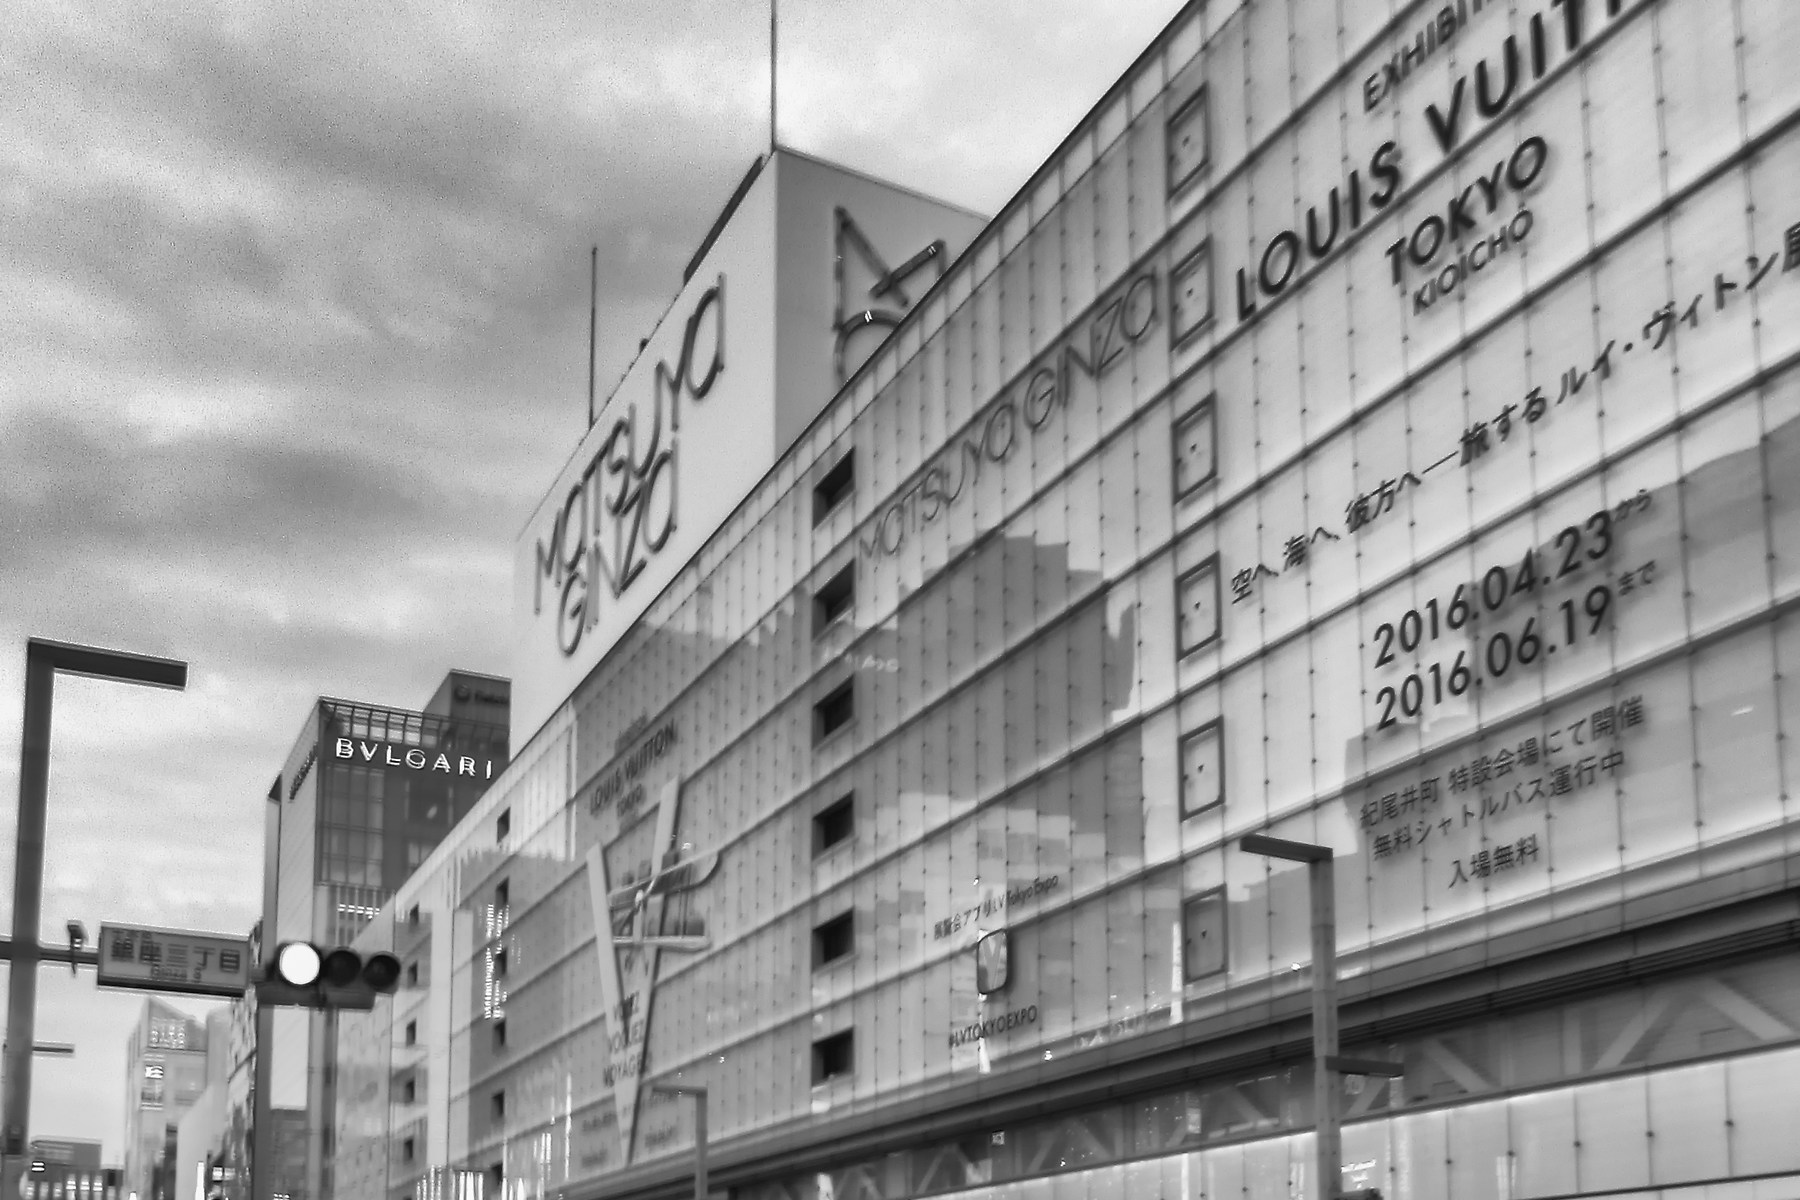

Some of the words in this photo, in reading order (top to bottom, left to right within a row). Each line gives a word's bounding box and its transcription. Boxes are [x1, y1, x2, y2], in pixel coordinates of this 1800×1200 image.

[1236, 141, 1401, 321] LOUIS
[1424, 0, 1621, 154] VUIT
[1385, 136, 1547, 286] TOKYO
[1412, 209, 1533, 316] KIOICHO
[335, 737, 493, 780] BVLGARI
[1448, 833, 1540, 889] 入場無料
